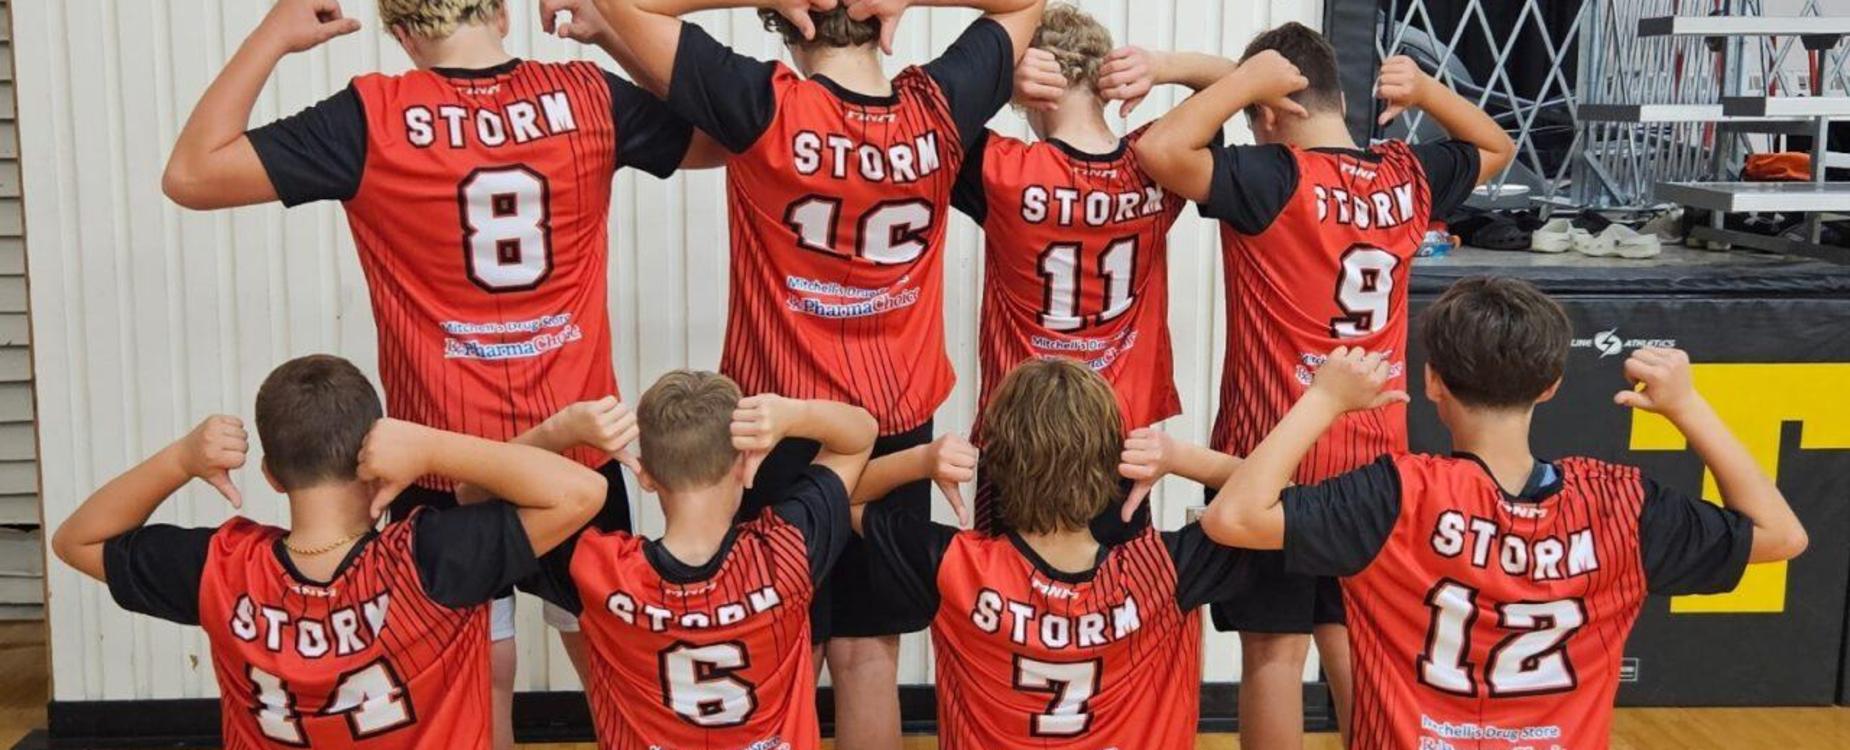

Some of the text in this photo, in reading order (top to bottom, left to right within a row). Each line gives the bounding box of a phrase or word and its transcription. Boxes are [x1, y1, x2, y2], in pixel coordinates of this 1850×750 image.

[403, 90, 578, 148] STORM
[792, 129, 941, 184] STORM
[457, 163, 554, 294] 8
[1021, 184, 1165, 228] STORM
[1035, 233, 1139, 332] 11
[1329, 242, 1401, 339] 9
[1570, 339, 1592, 347] LINE
[1430, 509, 1601, 583] STORM
[971, 586, 1142, 649] STORM
[1416, 576, 1590, 698] 12
[244, 655, 417, 748] 14
[657, 639, 759, 728] 6
[1012, 652, 1104, 738] 7
[1484, 726, 1520, 742] Drug
[1521, 725, 1560, 739] Store
